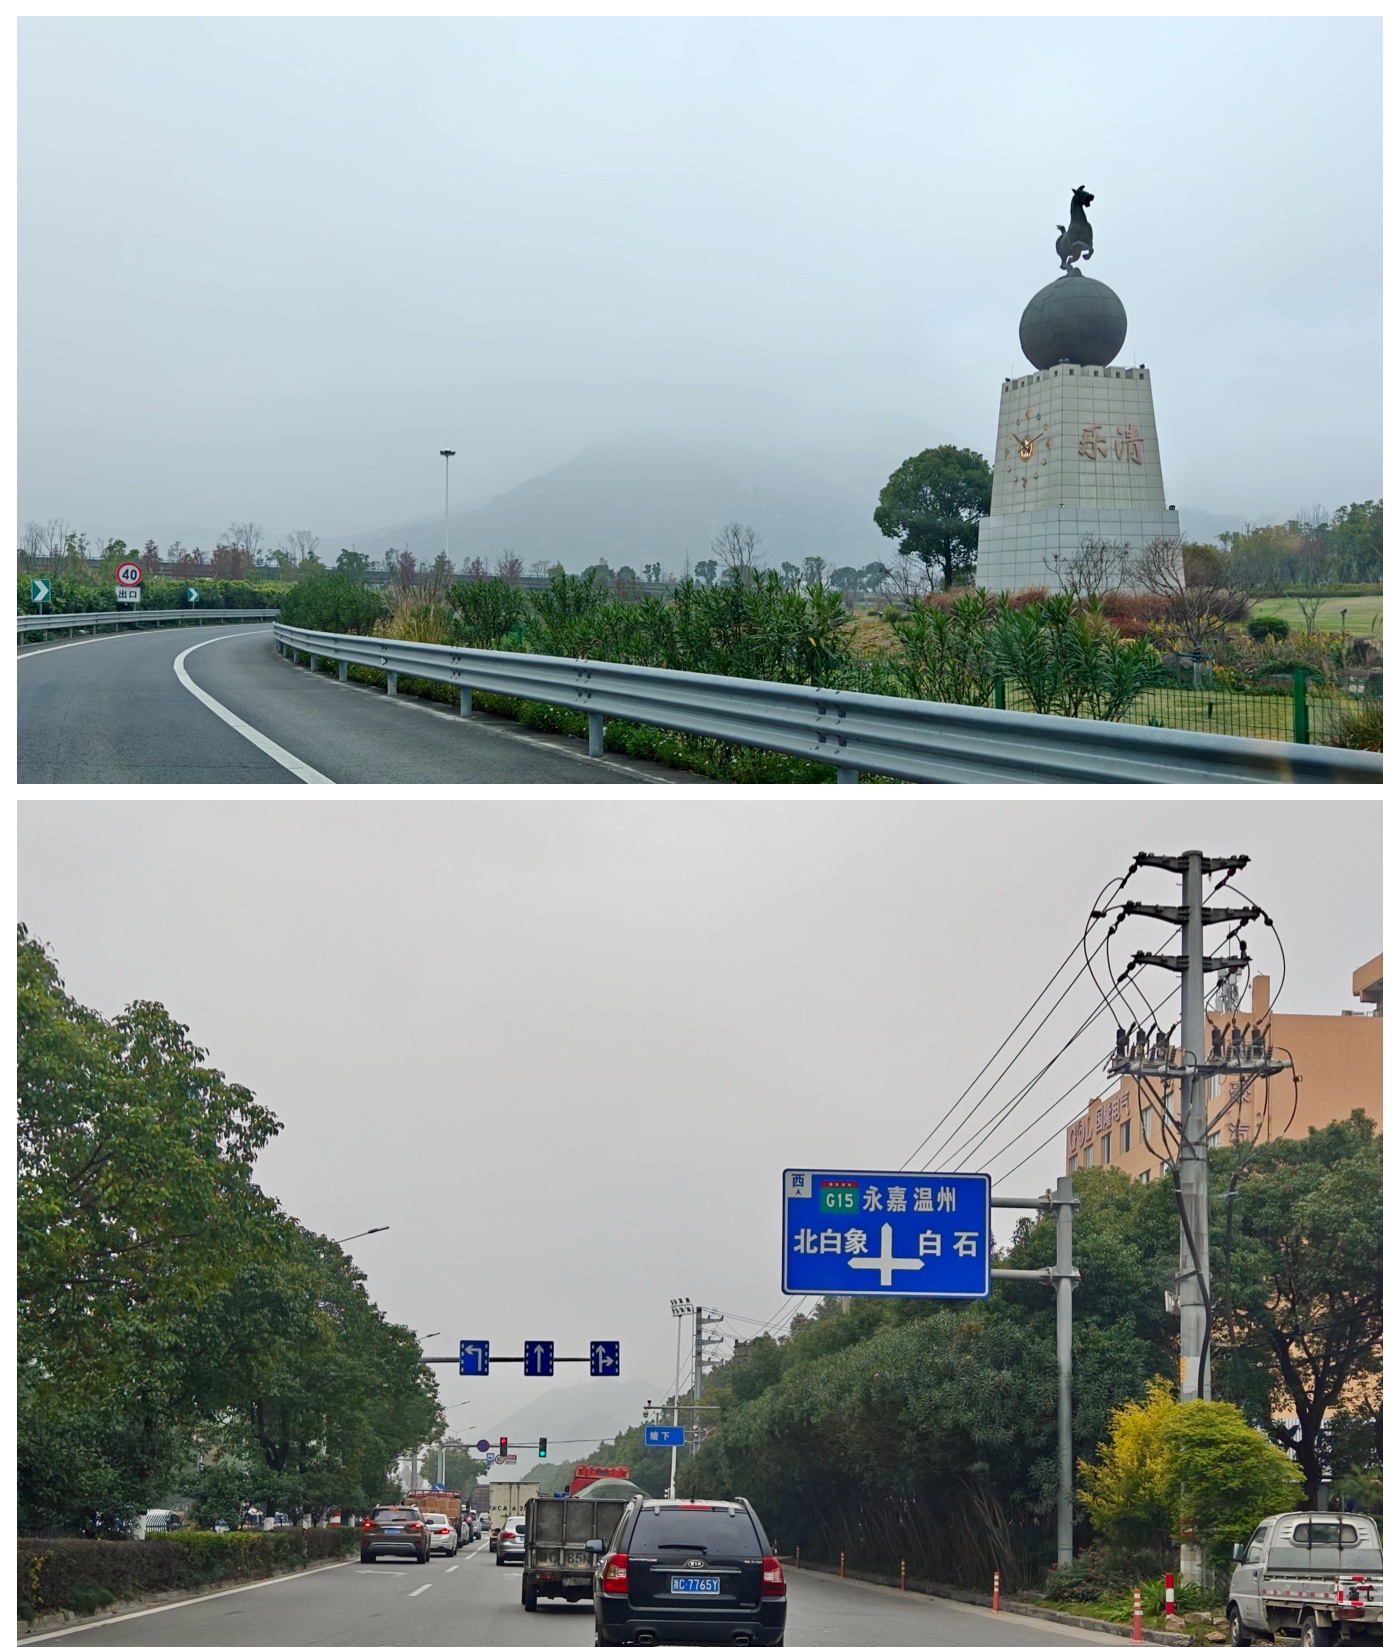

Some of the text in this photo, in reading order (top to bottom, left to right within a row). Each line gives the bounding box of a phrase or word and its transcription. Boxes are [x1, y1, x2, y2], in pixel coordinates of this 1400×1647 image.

[1078, 422, 1144, 465] 乐清
[122, 568, 138, 580] 40
[118, 589, 137, 599] 出口
[791, 1174, 805, 1188] 西
[826, 1193, 854, 1208] G15
[793, 1228, 979, 1257] 北白象 白石
